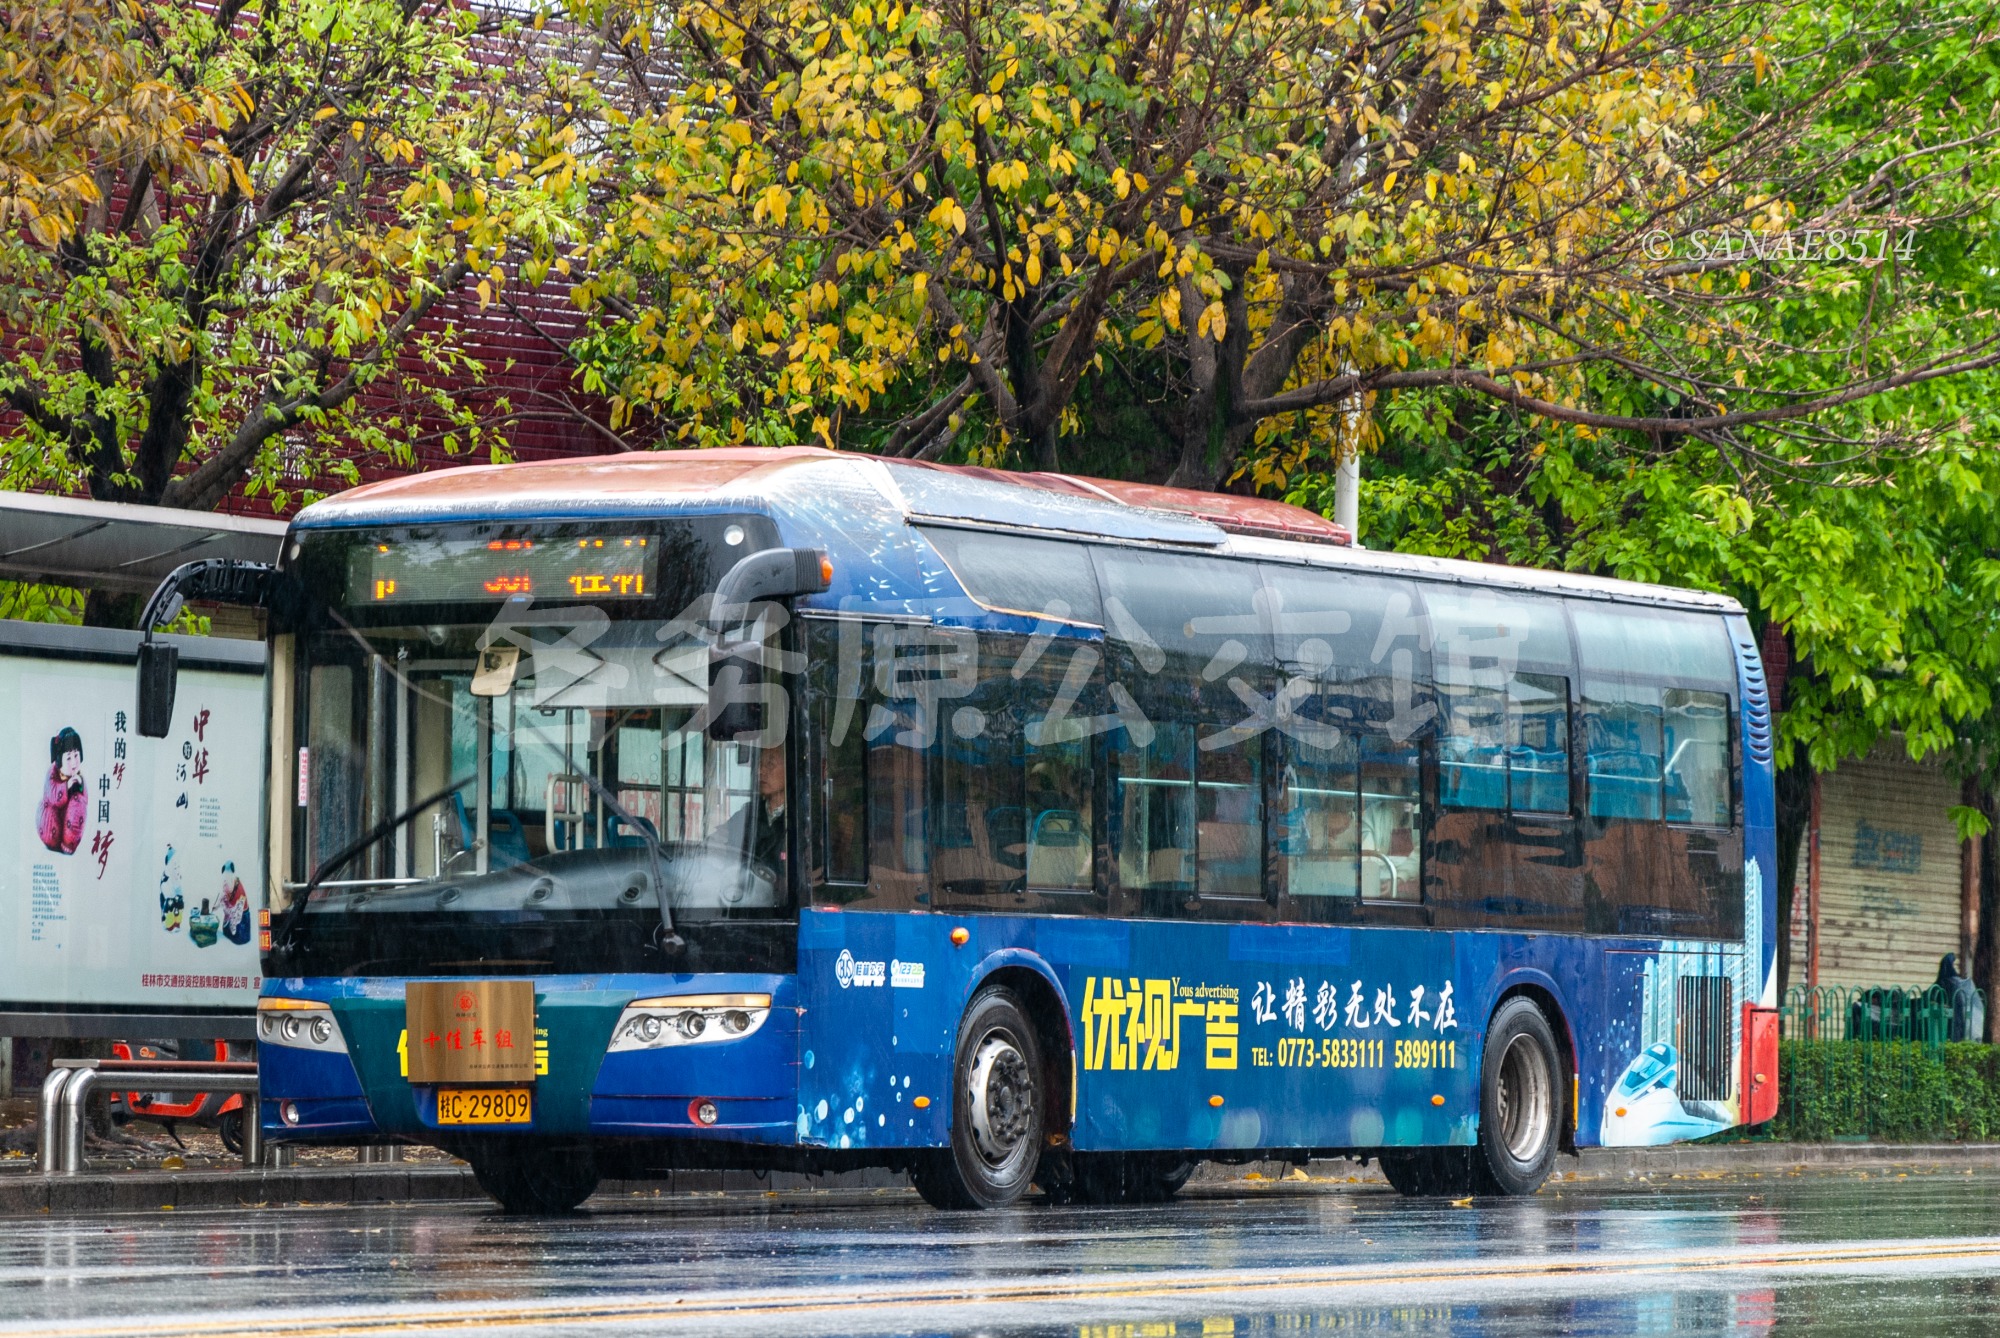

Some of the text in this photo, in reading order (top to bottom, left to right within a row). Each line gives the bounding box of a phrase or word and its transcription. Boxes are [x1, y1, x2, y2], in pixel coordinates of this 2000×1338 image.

[113, 710, 127, 790] 我的梦
[192, 703, 210, 785] 中华
[91, 773, 115, 880] 中国梦
[142, 973, 248, 990] 桂林市交通投资控股集团有限公司
[1171, 977, 1239, 1003] Yous advertising
[1251, 976, 1458, 1035] 让精彩无处不在
[423, 1027, 515, 1051] 十佳车组
[1081, 976, 1239, 1071] 优视广告
[1252, 1037, 1456, 1069] TEL: 0773-5833111 5899111
